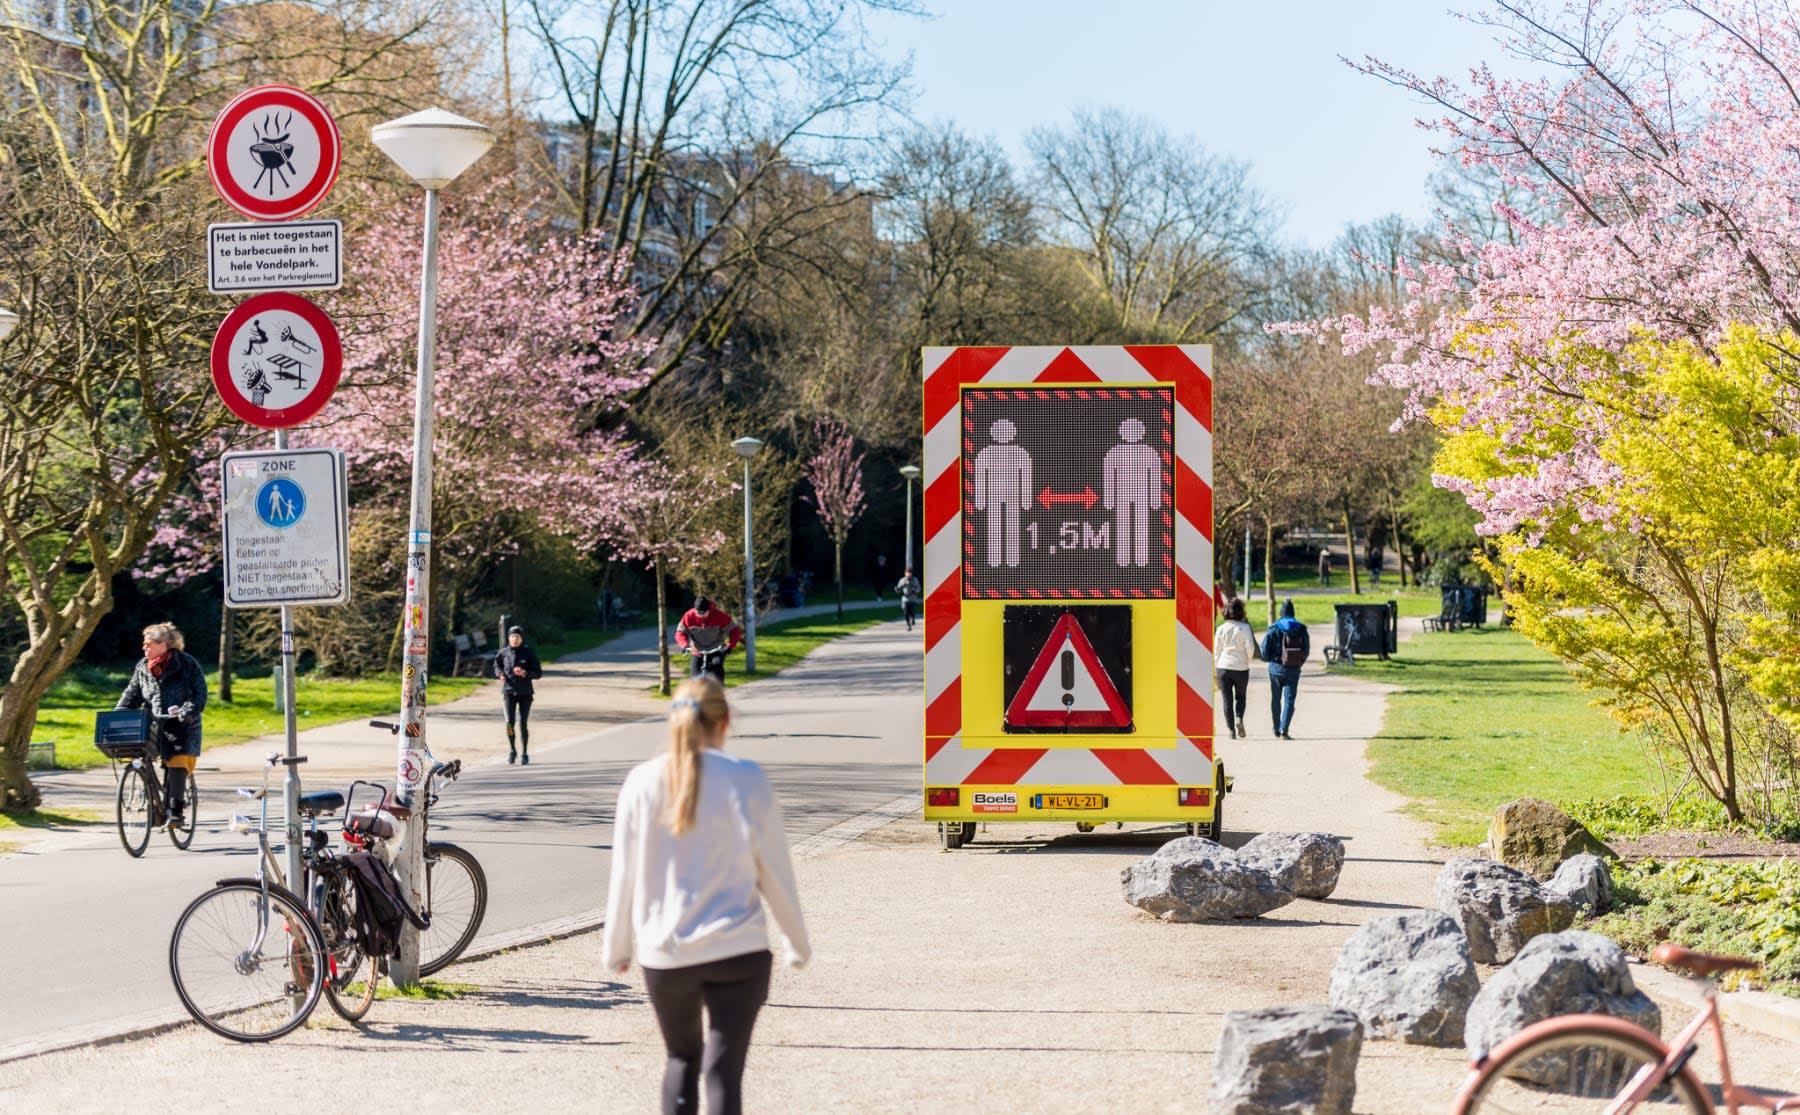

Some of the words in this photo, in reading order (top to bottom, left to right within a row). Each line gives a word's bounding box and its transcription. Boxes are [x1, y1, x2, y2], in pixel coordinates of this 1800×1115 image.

[216, 232, 236, 242] Het
[239, 232, 247, 240] is
[250, 231, 270, 240] niet
[274, 230, 333, 241] toegestaan
[220, 248, 231, 256] te
[234, 245, 296, 256] barbecueën
[299, 244, 308, 254] in
[312, 244, 329, 253] het
[230, 260, 252, 270] hele
[256, 258, 319, 270] Vondelpark.
[278, 272, 332, 281] Parkreglement
[262, 460, 296, 472] ZONE
[269, 549, 280, 557] op
[238, 573, 260, 583] NIET
[238, 587, 264, 596] brom-
[267, 586, 278, 594] en
[975, 794, 1016, 803] Boels
[1048, 796, 1096, 806] WL-VL-21
